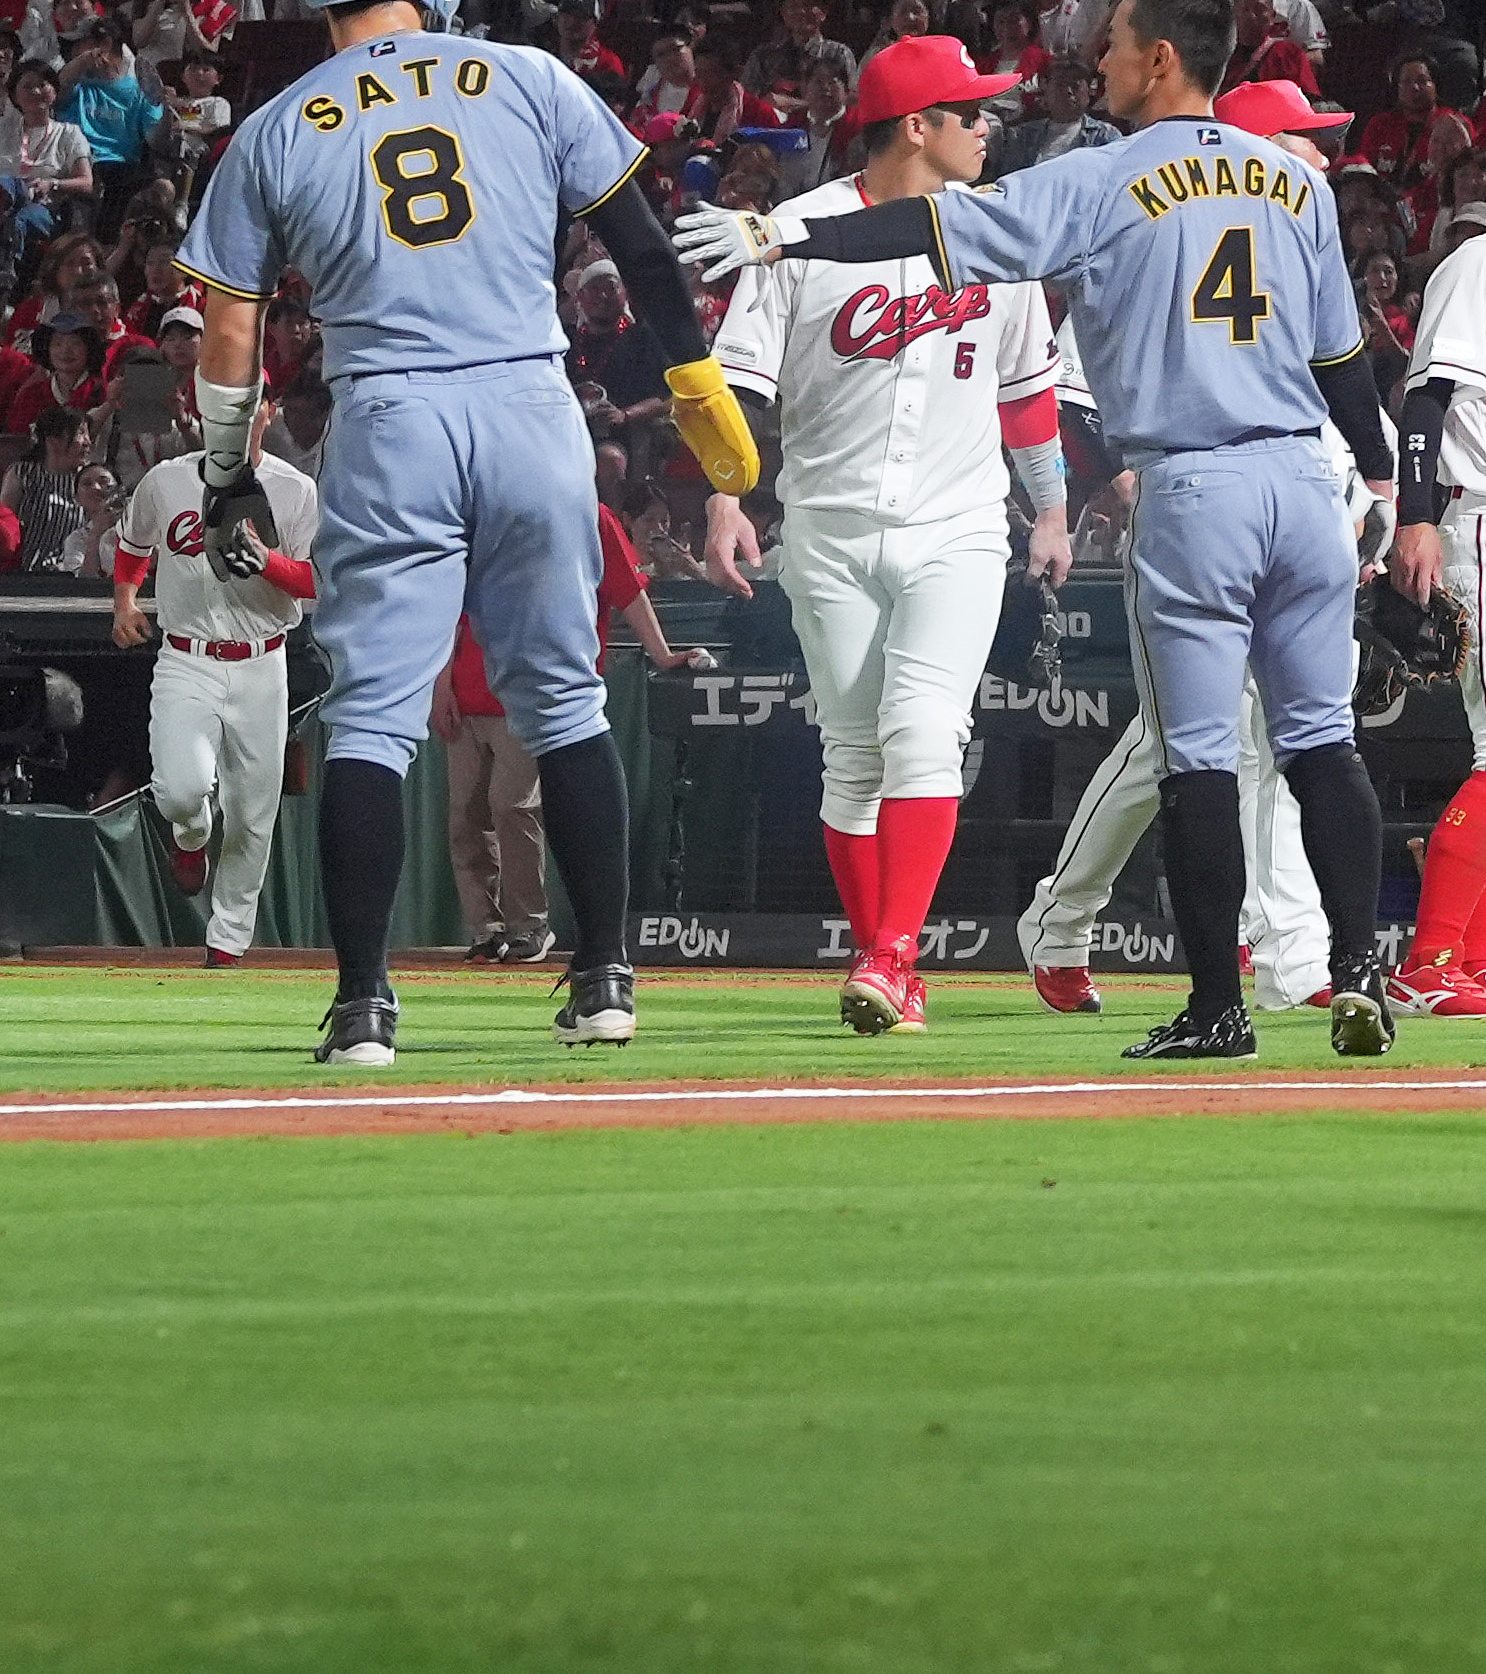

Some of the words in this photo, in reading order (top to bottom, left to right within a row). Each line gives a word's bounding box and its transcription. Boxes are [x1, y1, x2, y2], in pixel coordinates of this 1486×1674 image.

[303, 57, 491, 133] SATO
[369, 124, 477, 251] 8
[1127, 156, 1310, 220] KUMAGAI
[831, 283, 991, 366] Carp
[1190, 225, 1272, 346] 4
[953, 342, 977, 380] 5
